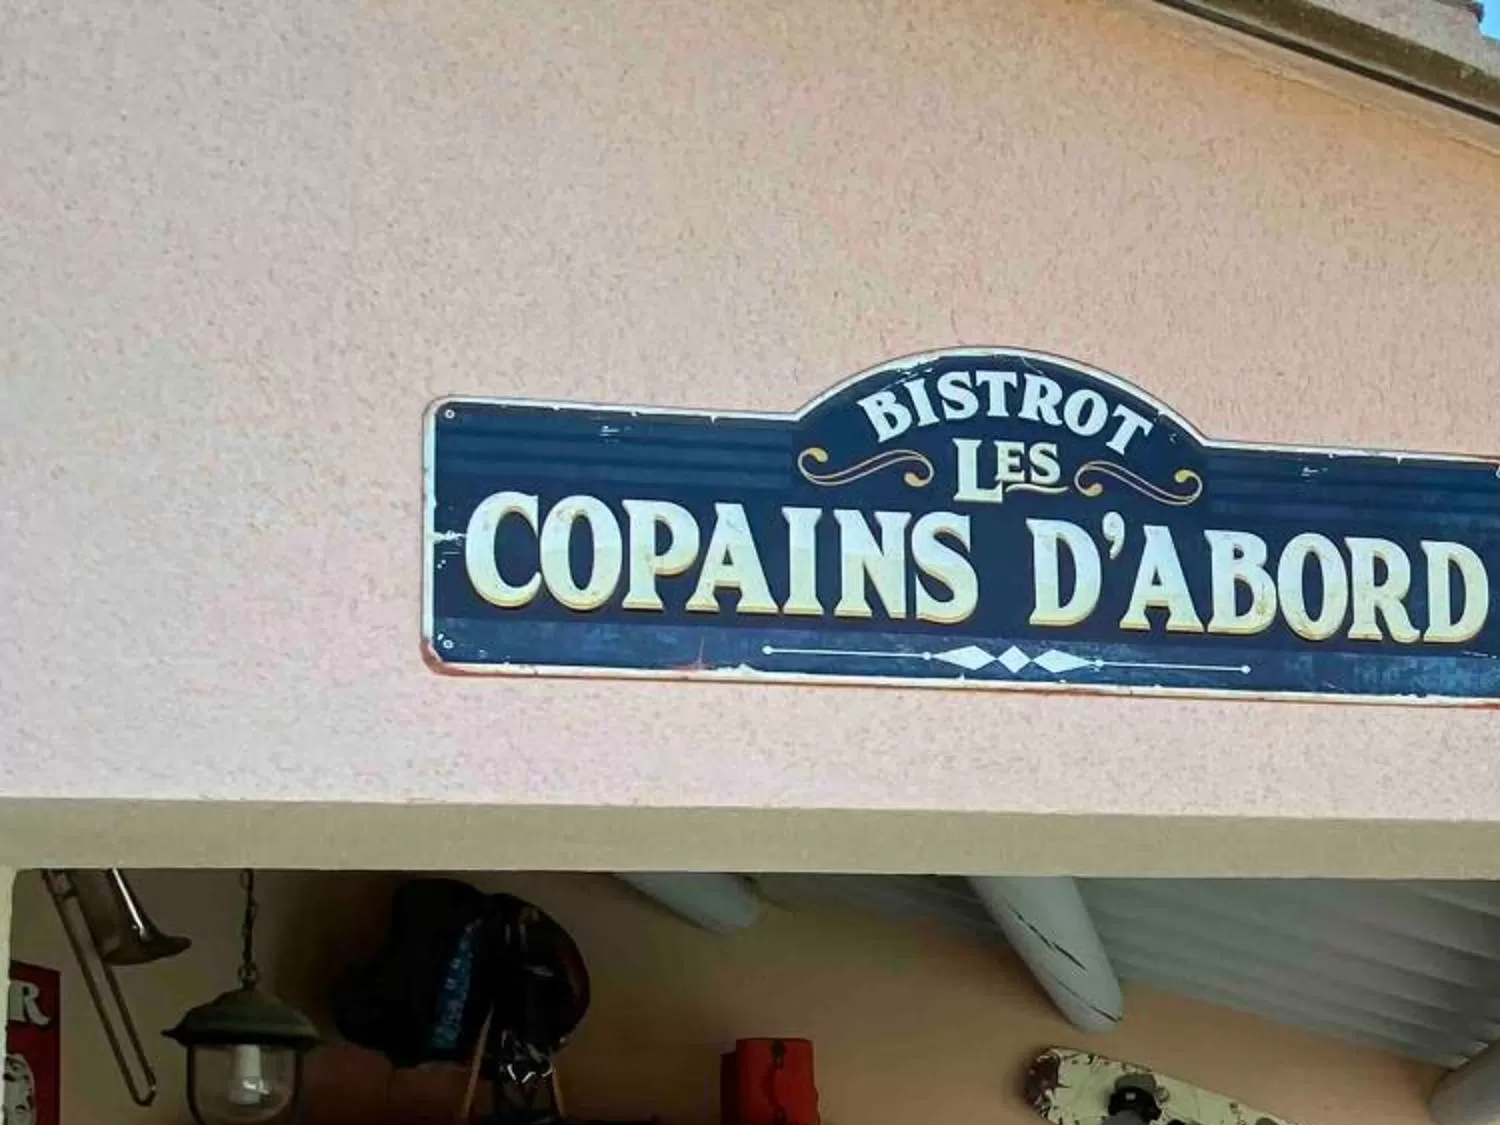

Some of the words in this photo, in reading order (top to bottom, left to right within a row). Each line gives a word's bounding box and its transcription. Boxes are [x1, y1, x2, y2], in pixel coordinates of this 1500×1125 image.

[856, 370, 1154, 455] BISTROT
[465, 490, 979, 624] COPAINS
[1025, 511, 1489, 644] D'ABORD
